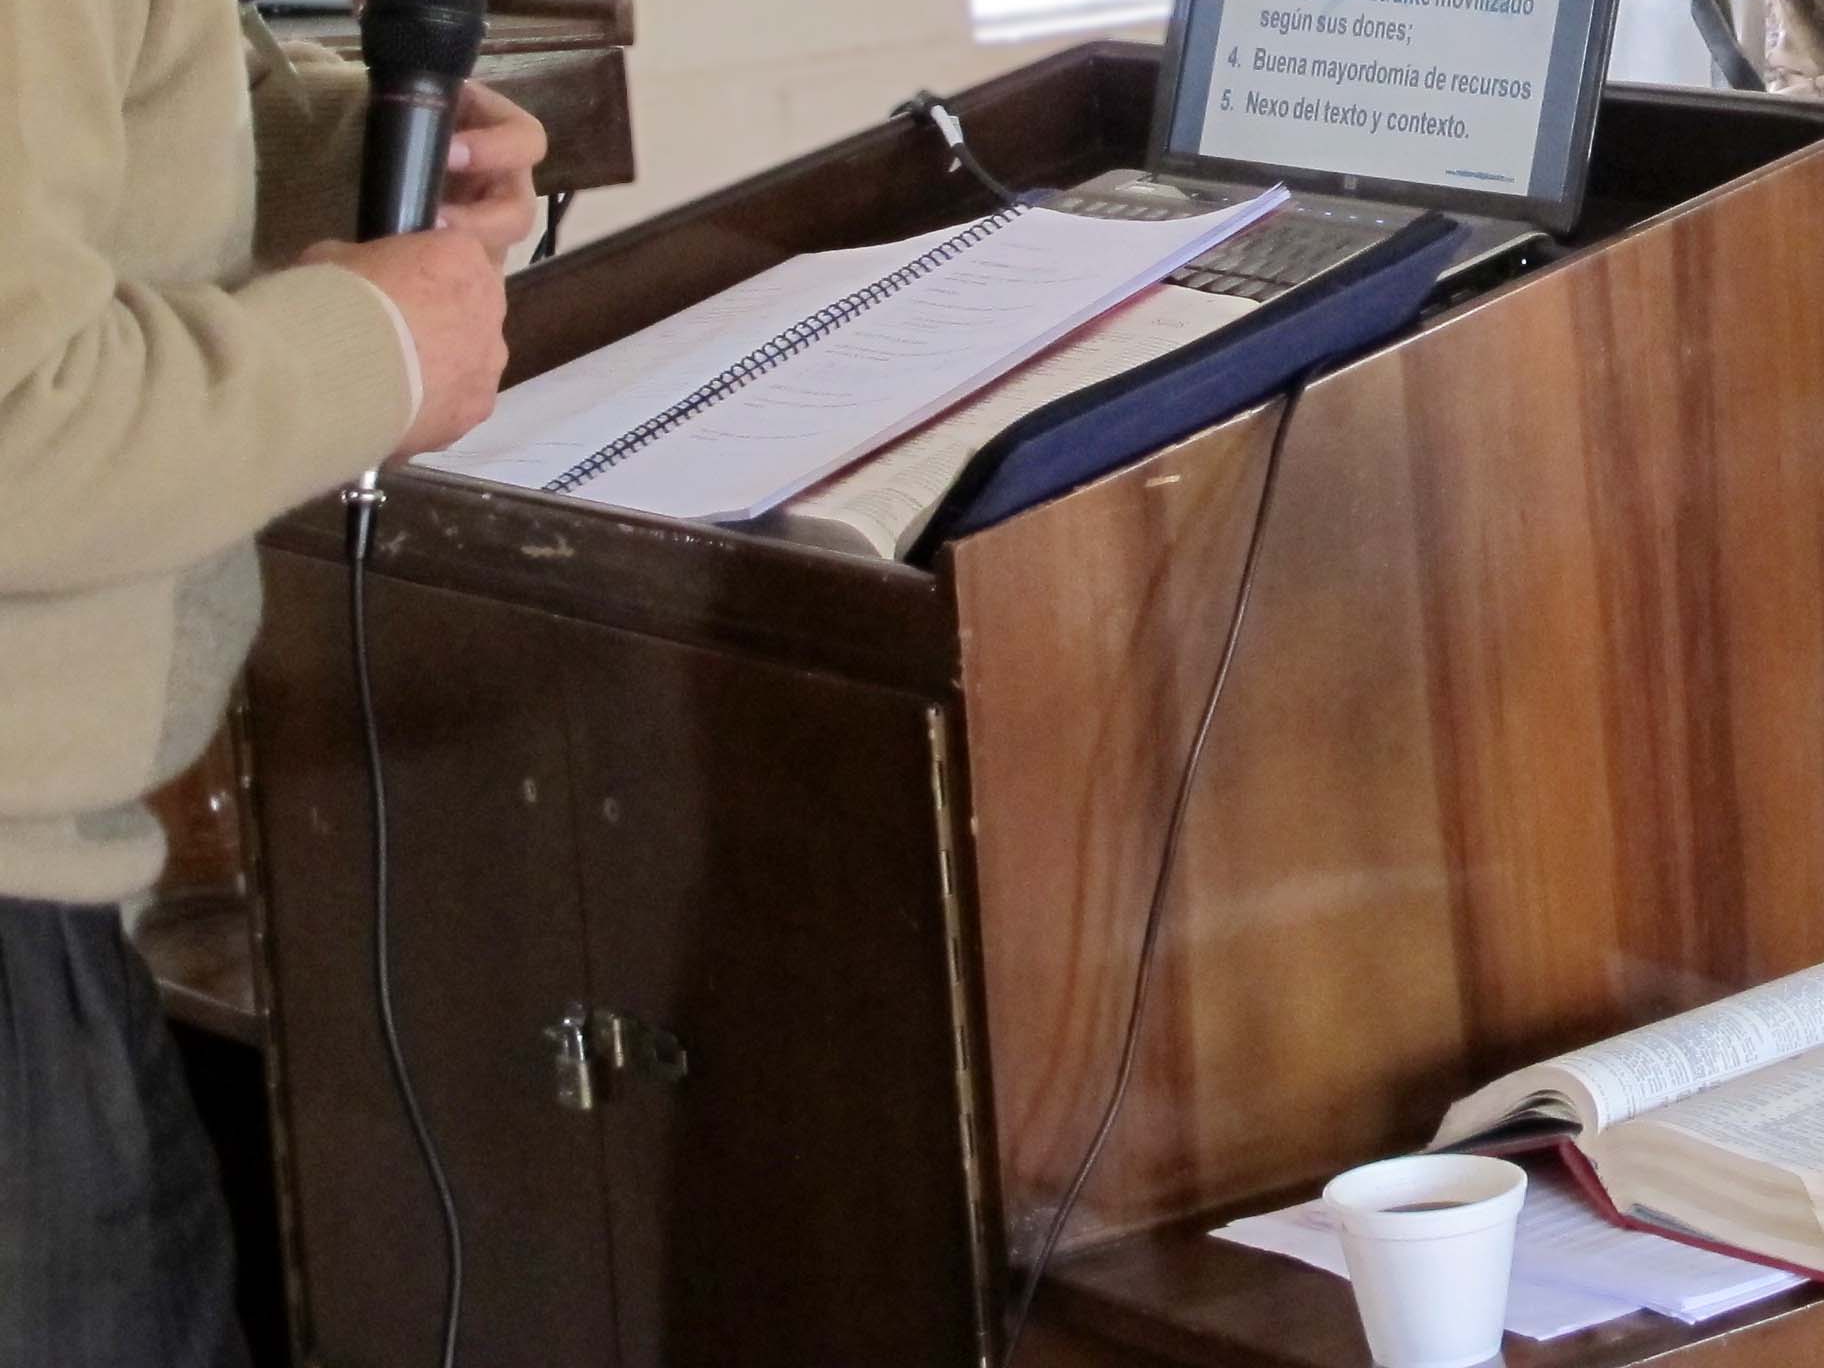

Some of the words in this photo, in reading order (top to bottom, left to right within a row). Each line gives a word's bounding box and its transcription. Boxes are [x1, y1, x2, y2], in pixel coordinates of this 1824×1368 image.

[1260, 8, 1313, 35] según
[1316, 13, 1348, 34] sus
[1352, 13, 1414, 45] dones;
[1228, 46, 1240, 68] 4.
[1253, 47, 1307, 75] Buena
[1311, 57, 1420, 87] mayordomía
[1424, 66, 1446, 90] de
[1451, 73, 1531, 100] recursos
[1220, 89, 1233, 111] 5.
[1246, 90, 1289, 118] Nexo
[1293, 97, 1320, 121] del
[1324, 100, 1367, 127] texto
[1370, 110, 1382, 134] y
[1387, 112, 1469, 139] contexto.
